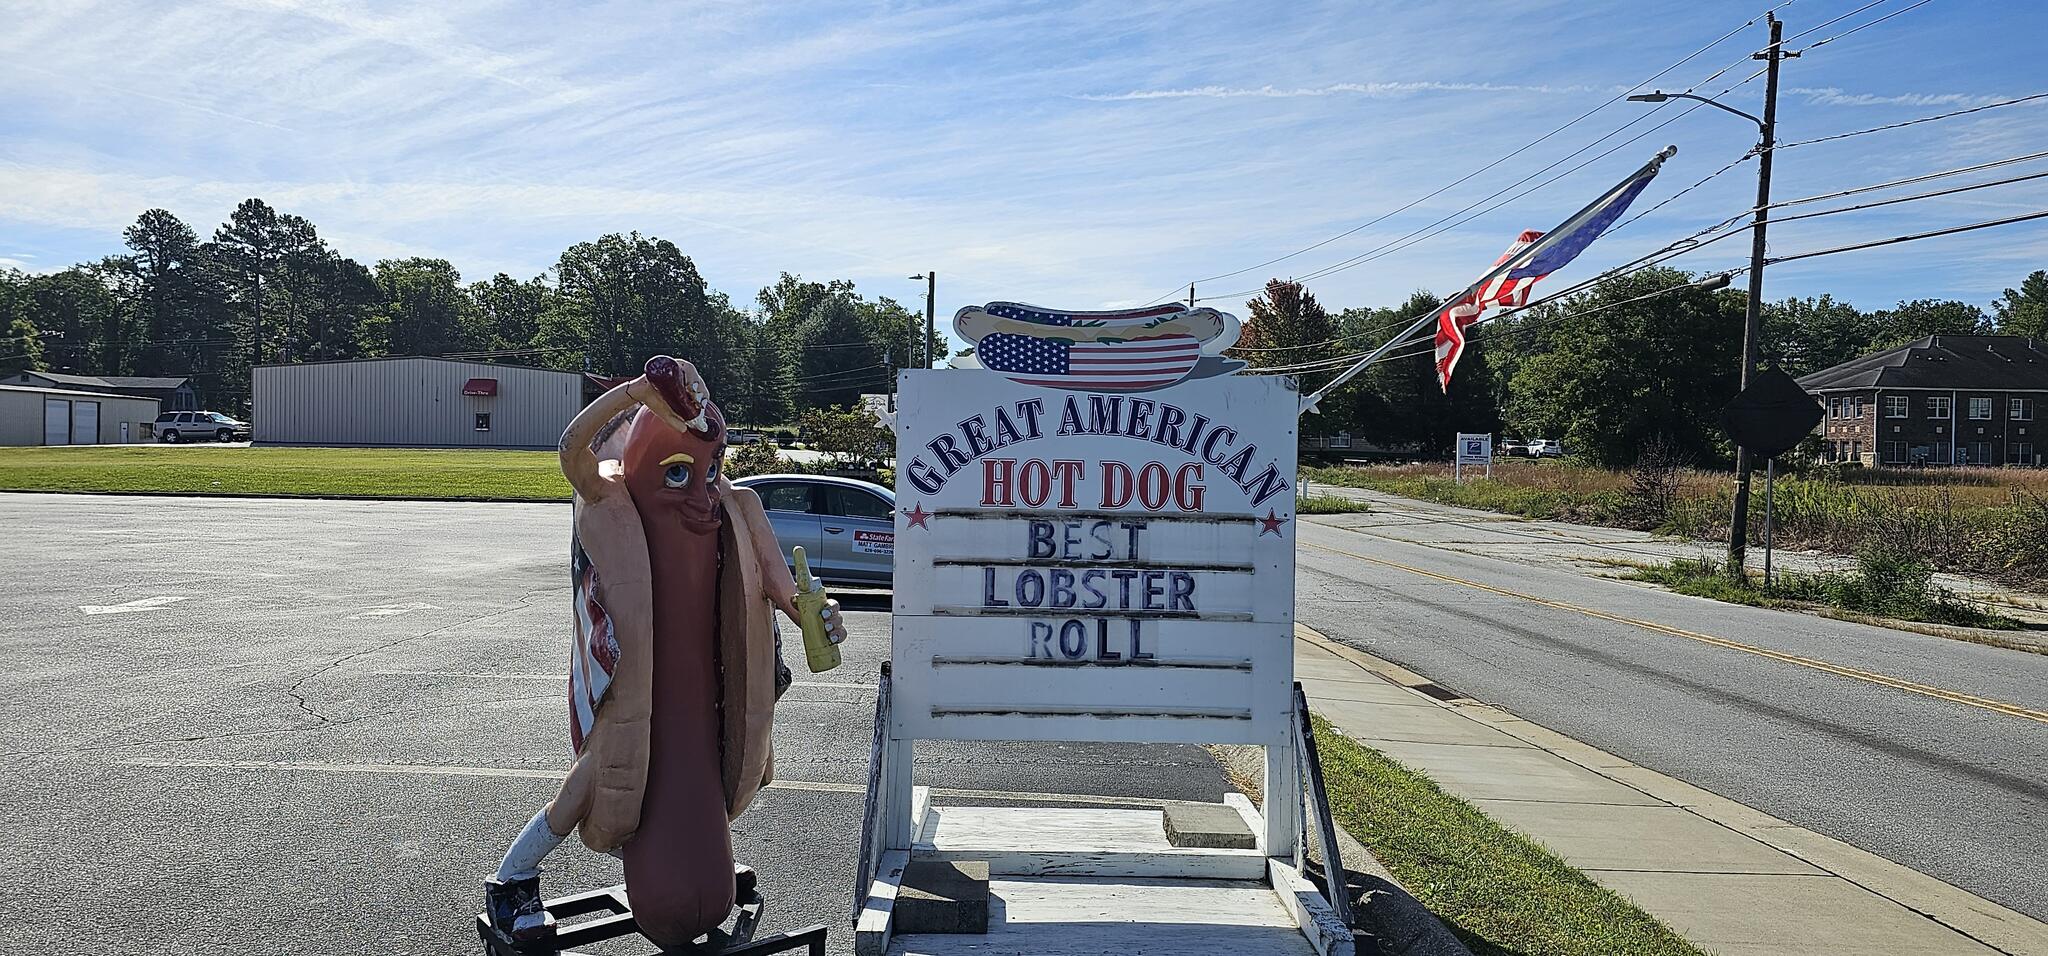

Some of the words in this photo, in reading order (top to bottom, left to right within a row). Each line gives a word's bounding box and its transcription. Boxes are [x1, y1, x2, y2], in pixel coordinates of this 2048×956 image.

[905, 396, 1045, 495] GREAT
[1057, 394, 1290, 508] AMERICAN
[980, 458, 1085, 509] HOT
[1099, 461, 1207, 512] DOG
[869, 533, 885, 542] State
[1028, 519, 1147, 561] BEST
[984, 567, 1196, 611] LOBSTER
[1031, 618, 1155, 660] ROLL
